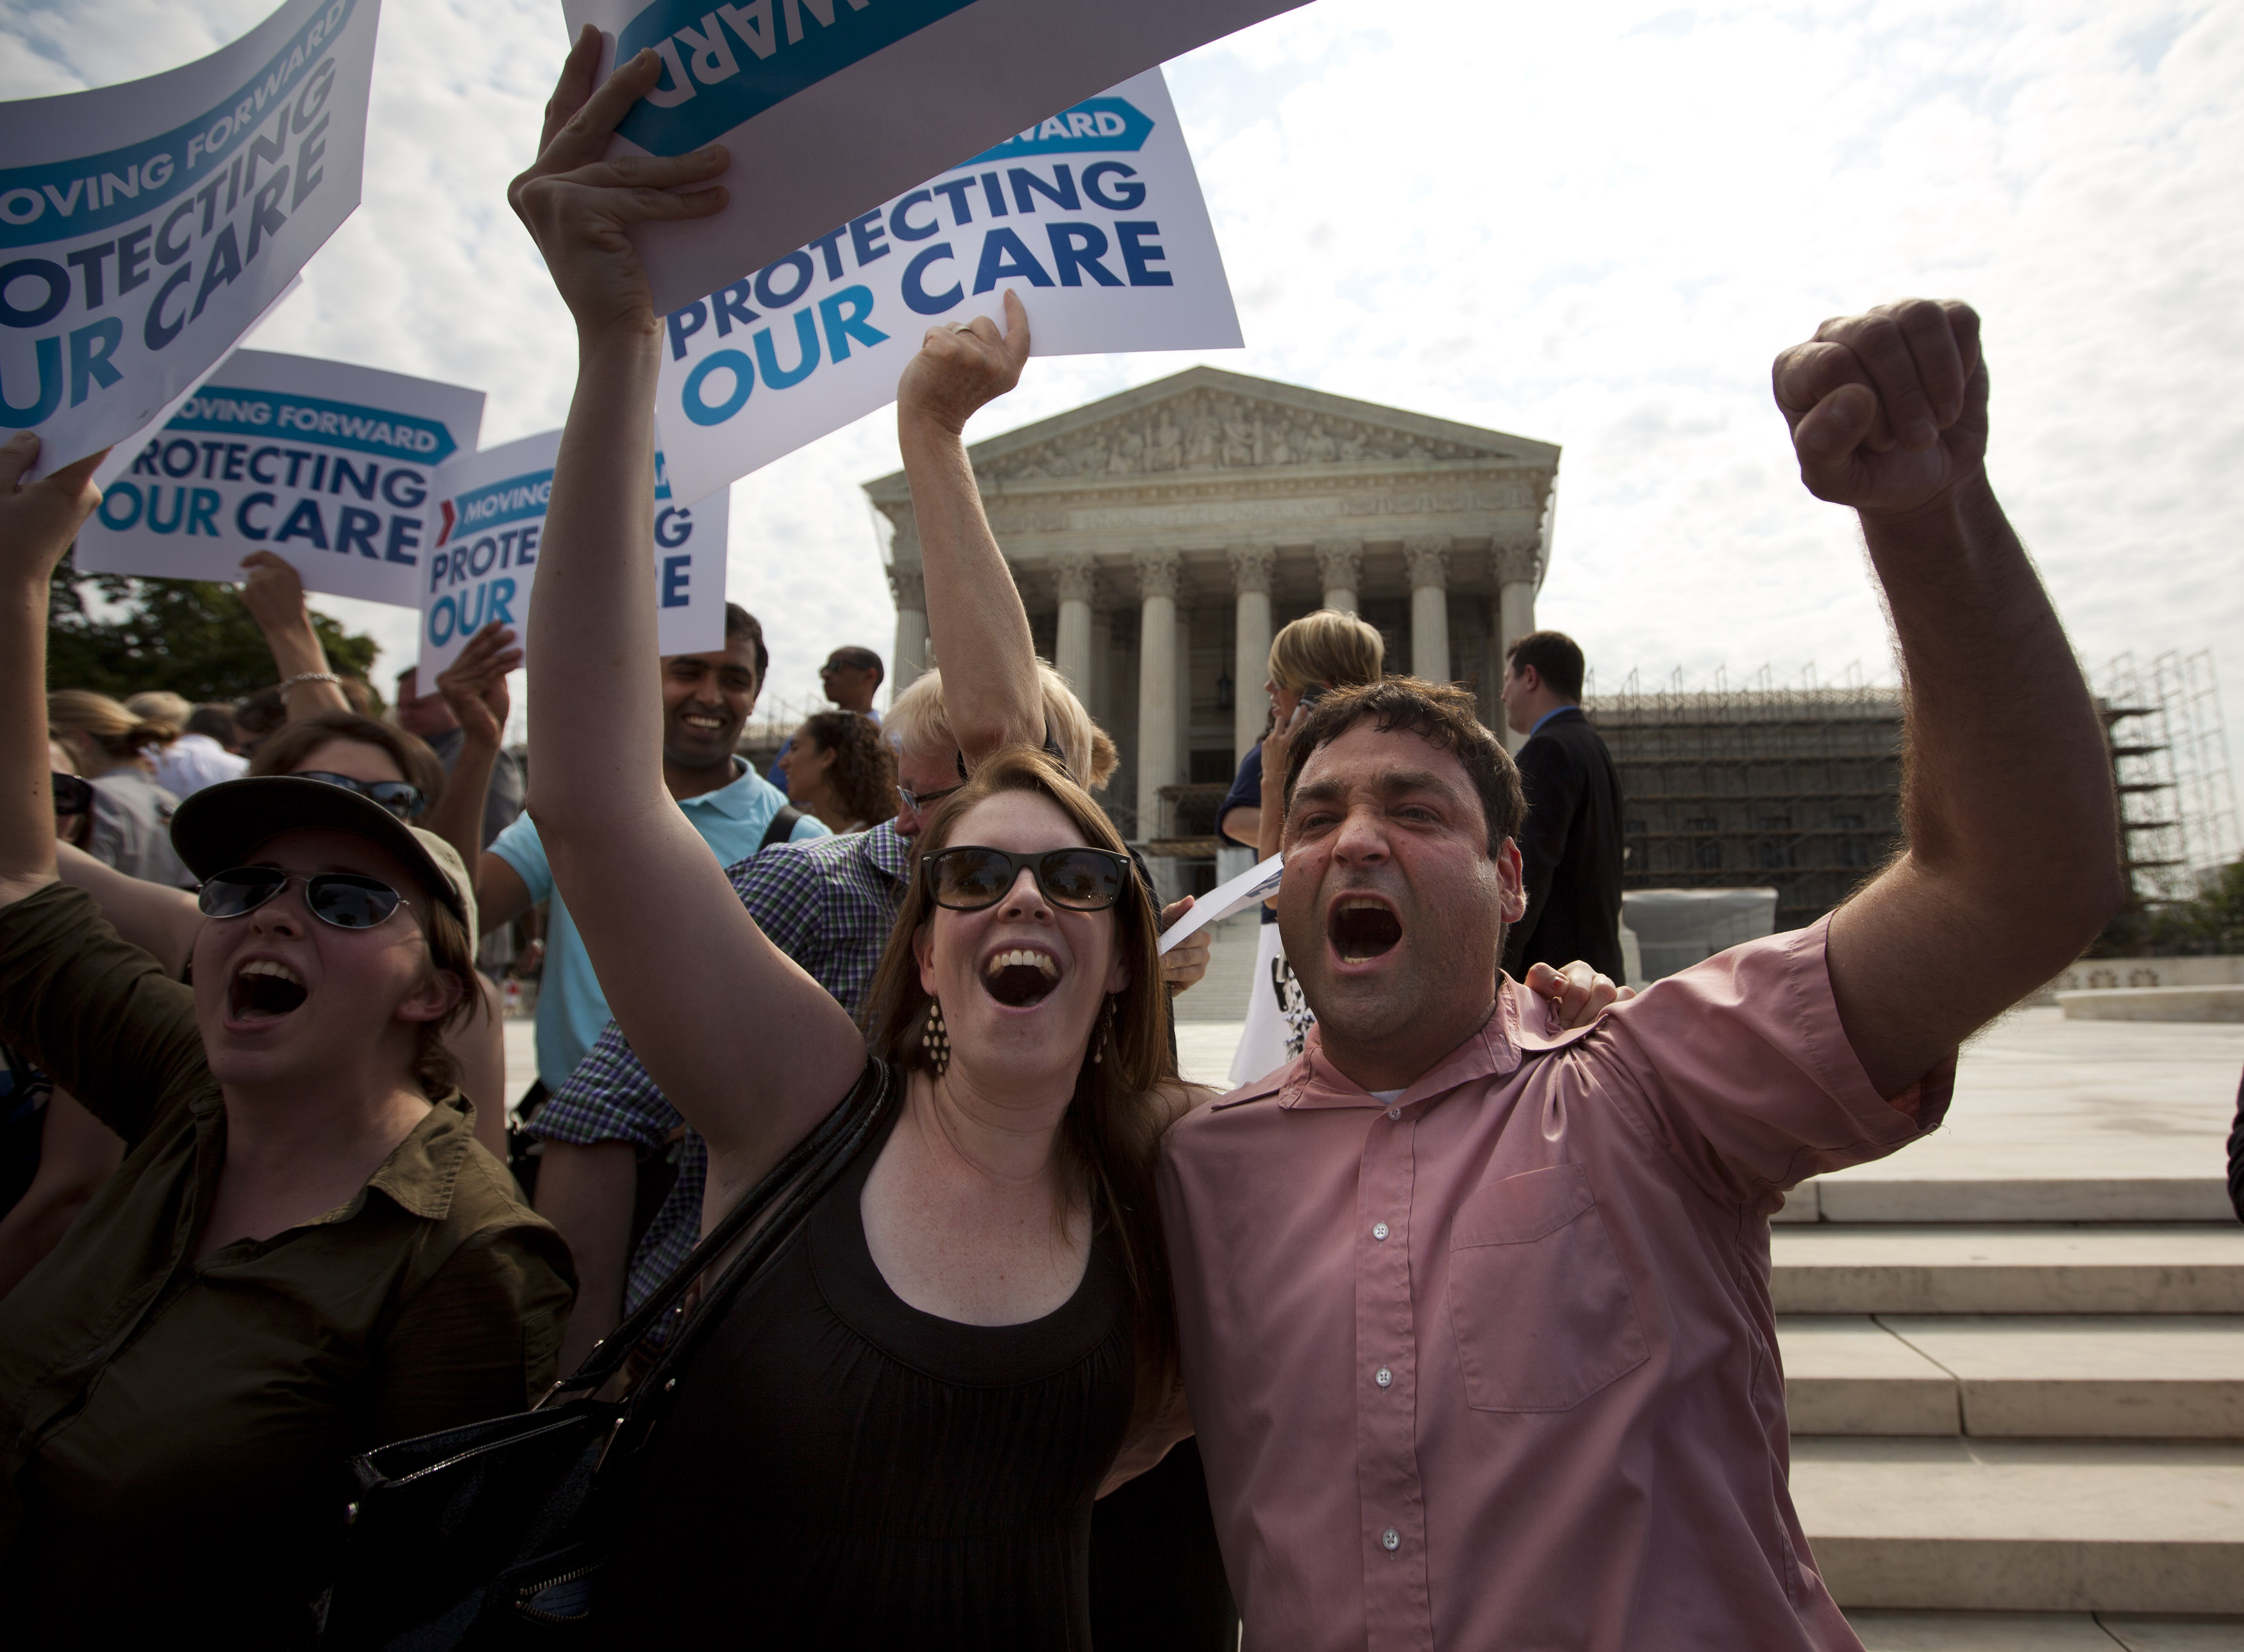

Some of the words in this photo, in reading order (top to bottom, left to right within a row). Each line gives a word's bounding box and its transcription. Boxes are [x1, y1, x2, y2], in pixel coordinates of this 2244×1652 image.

[187, 0, 346, 170] FORWARD
[144, 112, 330, 351] CARE
[667, 160, 1146, 361] PROTECTING
[682, 284, 891, 426] OUR
[901, 222, 1174, 315] CARE
[178, 396, 271, 425] OVING
[278, 405, 438, 453] FORWARD
[131, 437, 427, 508] ROTECTING
[464, 481, 553, 524] MOVING
[98, 481, 221, 537] OUR
[236, 492, 422, 565] CARE
[428, 578, 516, 647] OUR
